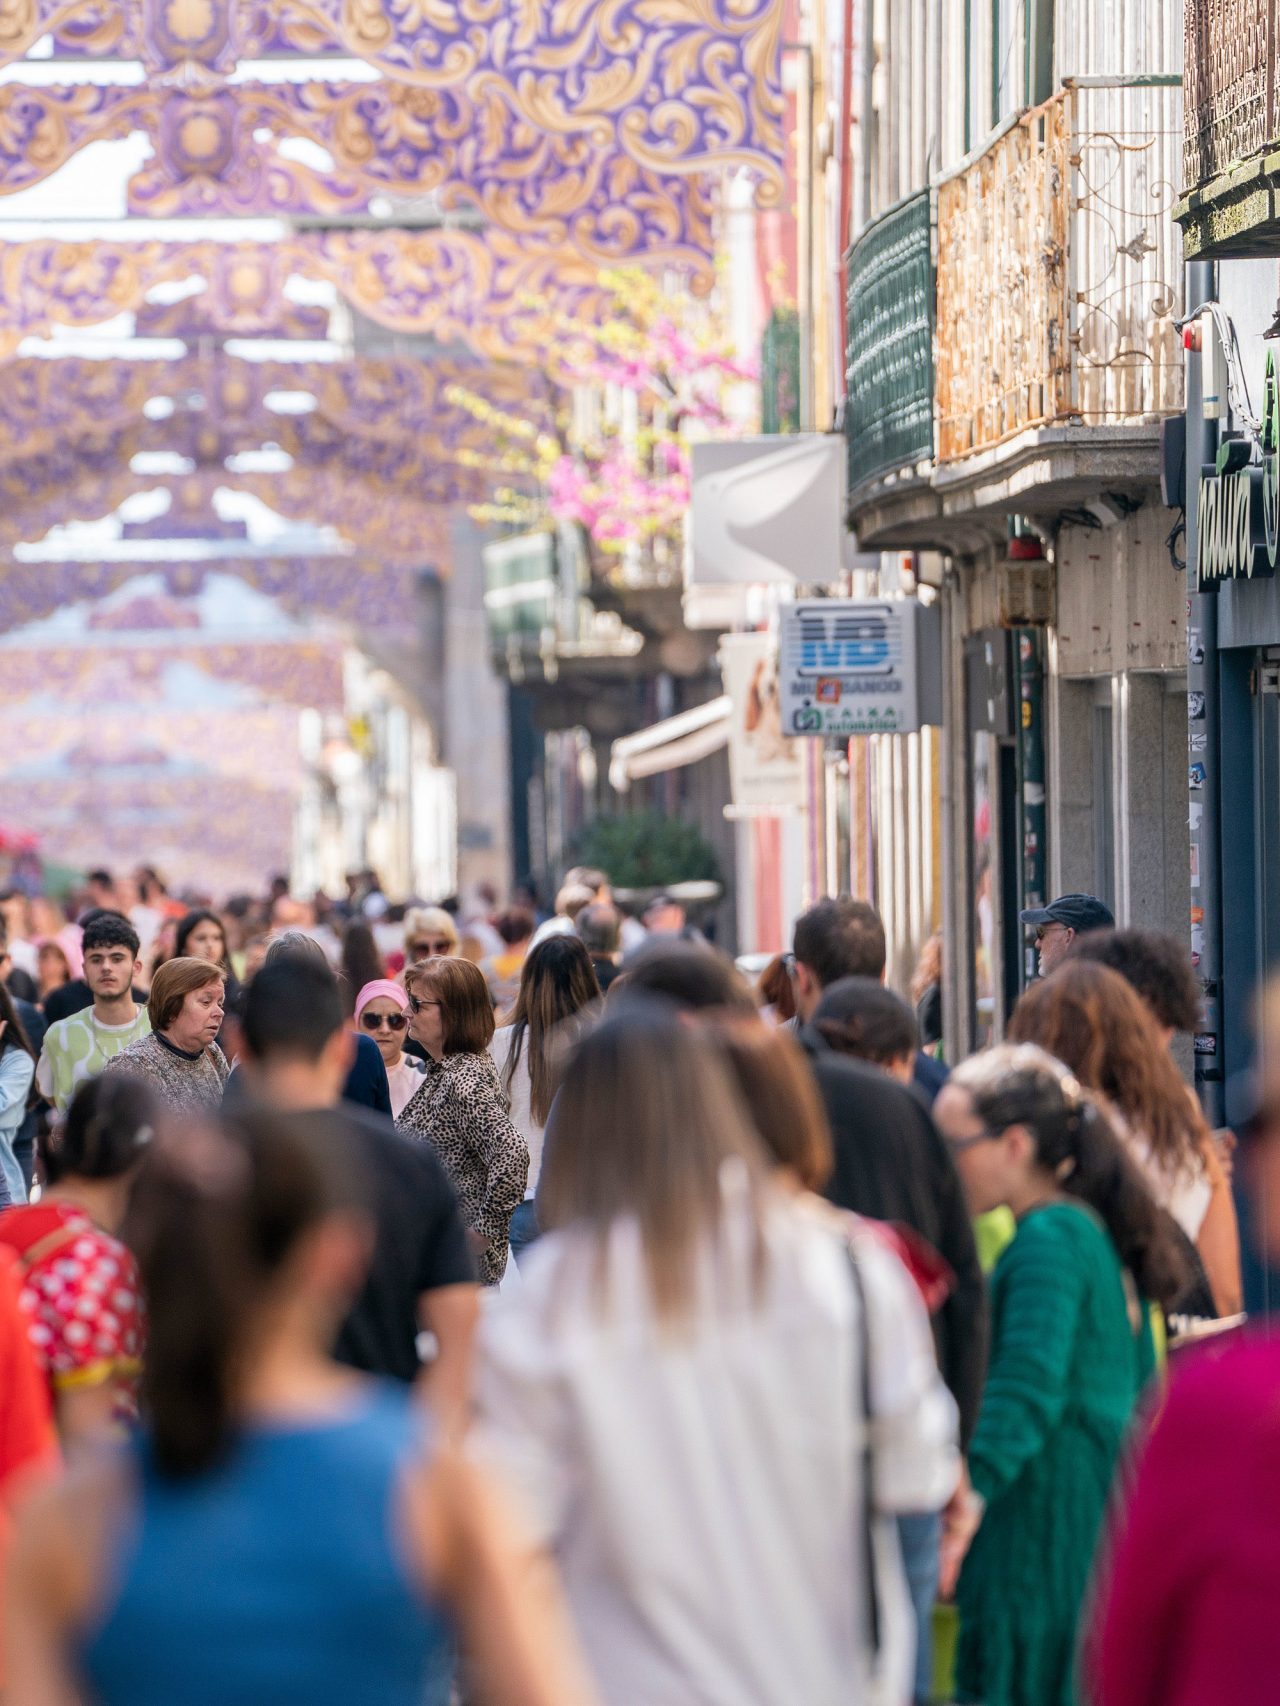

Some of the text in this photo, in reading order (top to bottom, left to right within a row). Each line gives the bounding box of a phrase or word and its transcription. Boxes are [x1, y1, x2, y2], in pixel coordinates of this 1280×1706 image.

[800, 617, 889, 667] MB
[790, 679, 902, 696] MUBANCO
[825, 706, 896, 718] CAIXA
